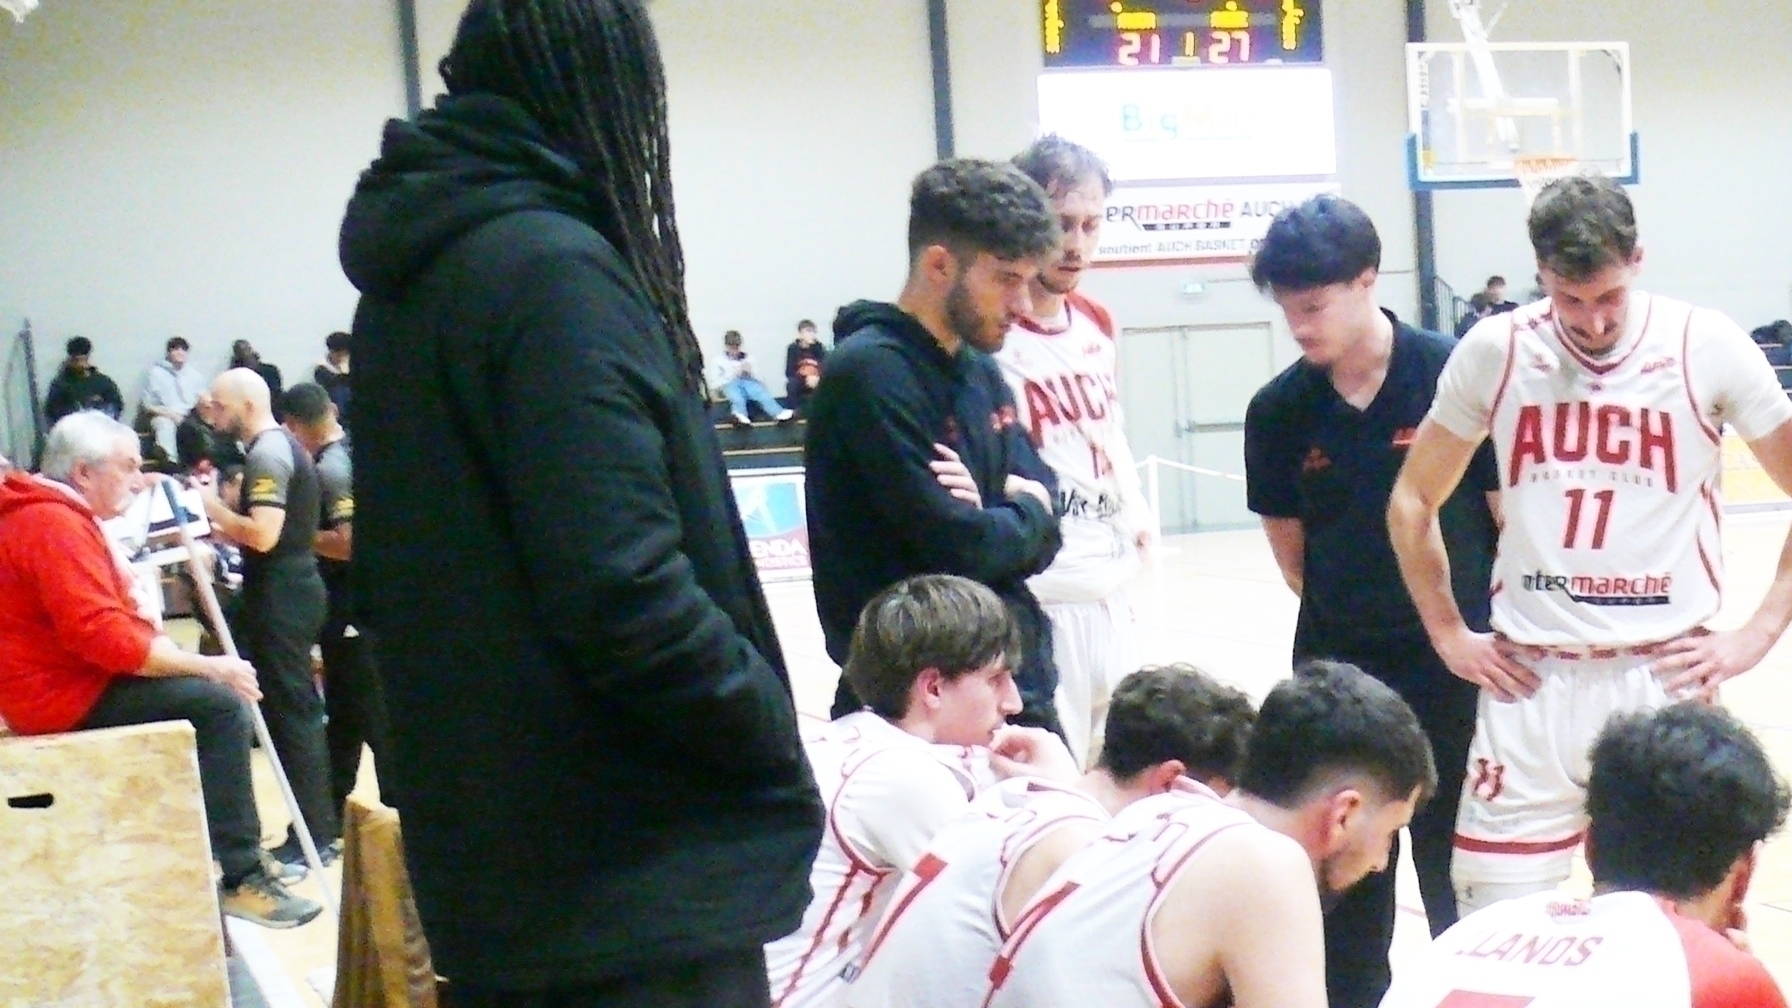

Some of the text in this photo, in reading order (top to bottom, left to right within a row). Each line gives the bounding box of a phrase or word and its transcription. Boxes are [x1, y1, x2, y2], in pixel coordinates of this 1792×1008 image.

[1118, 31, 1161, 66] 21
[1208, 30, 1250, 65] 27
[1509, 400, 1678, 494] AUCH
[1563, 488, 1615, 550] 11
